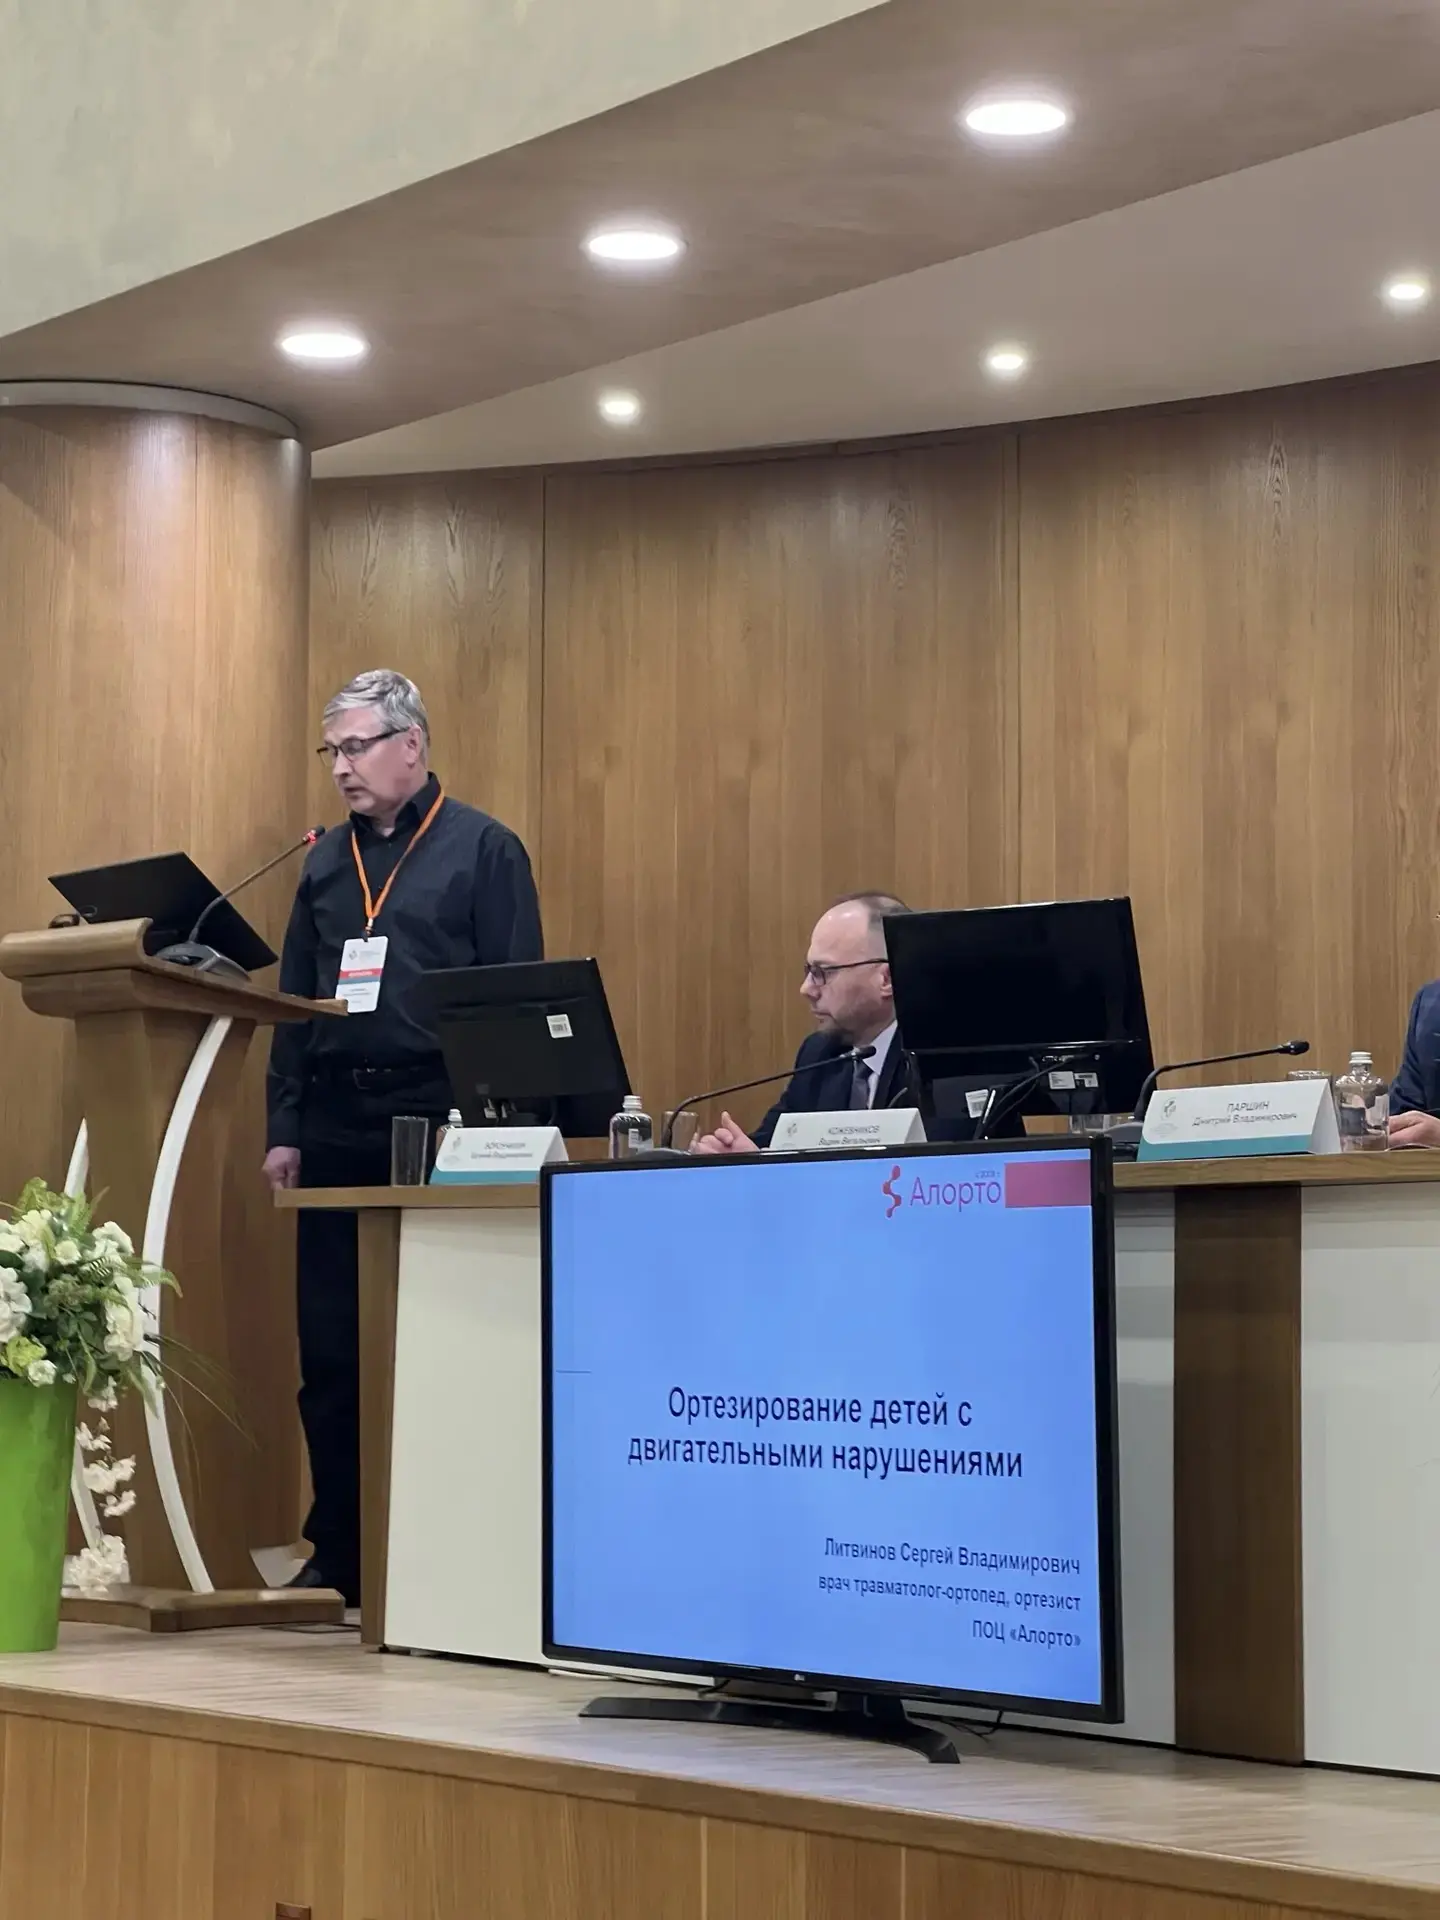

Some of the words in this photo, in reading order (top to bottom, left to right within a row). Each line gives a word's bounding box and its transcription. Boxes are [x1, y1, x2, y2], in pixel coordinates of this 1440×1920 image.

[910, 1176, 1002, 1212] Алорто
[668, 1386, 862, 1427] Ортезирование
[870, 1392, 948, 1430] детей
[957, 1401, 973, 1426] с
[627, 1436, 824, 1467] двигательными
[832, 1445, 1023, 1480] нарушениями
[824, 1537, 897, 1561] Литвинов
[900, 1542, 954, 1567] Сергей
[958, 1547, 1081, 1575] Владимирович
[818, 1575, 851, 1595] врач
[852, 1577, 1010, 1607] травматолог-ортопед,
[1014, 1591, 1081, 1611] ортезист
[972, 1619, 1006, 1643] ПОЦ
[1009, 1624, 1082, 1649] «Алорто»
